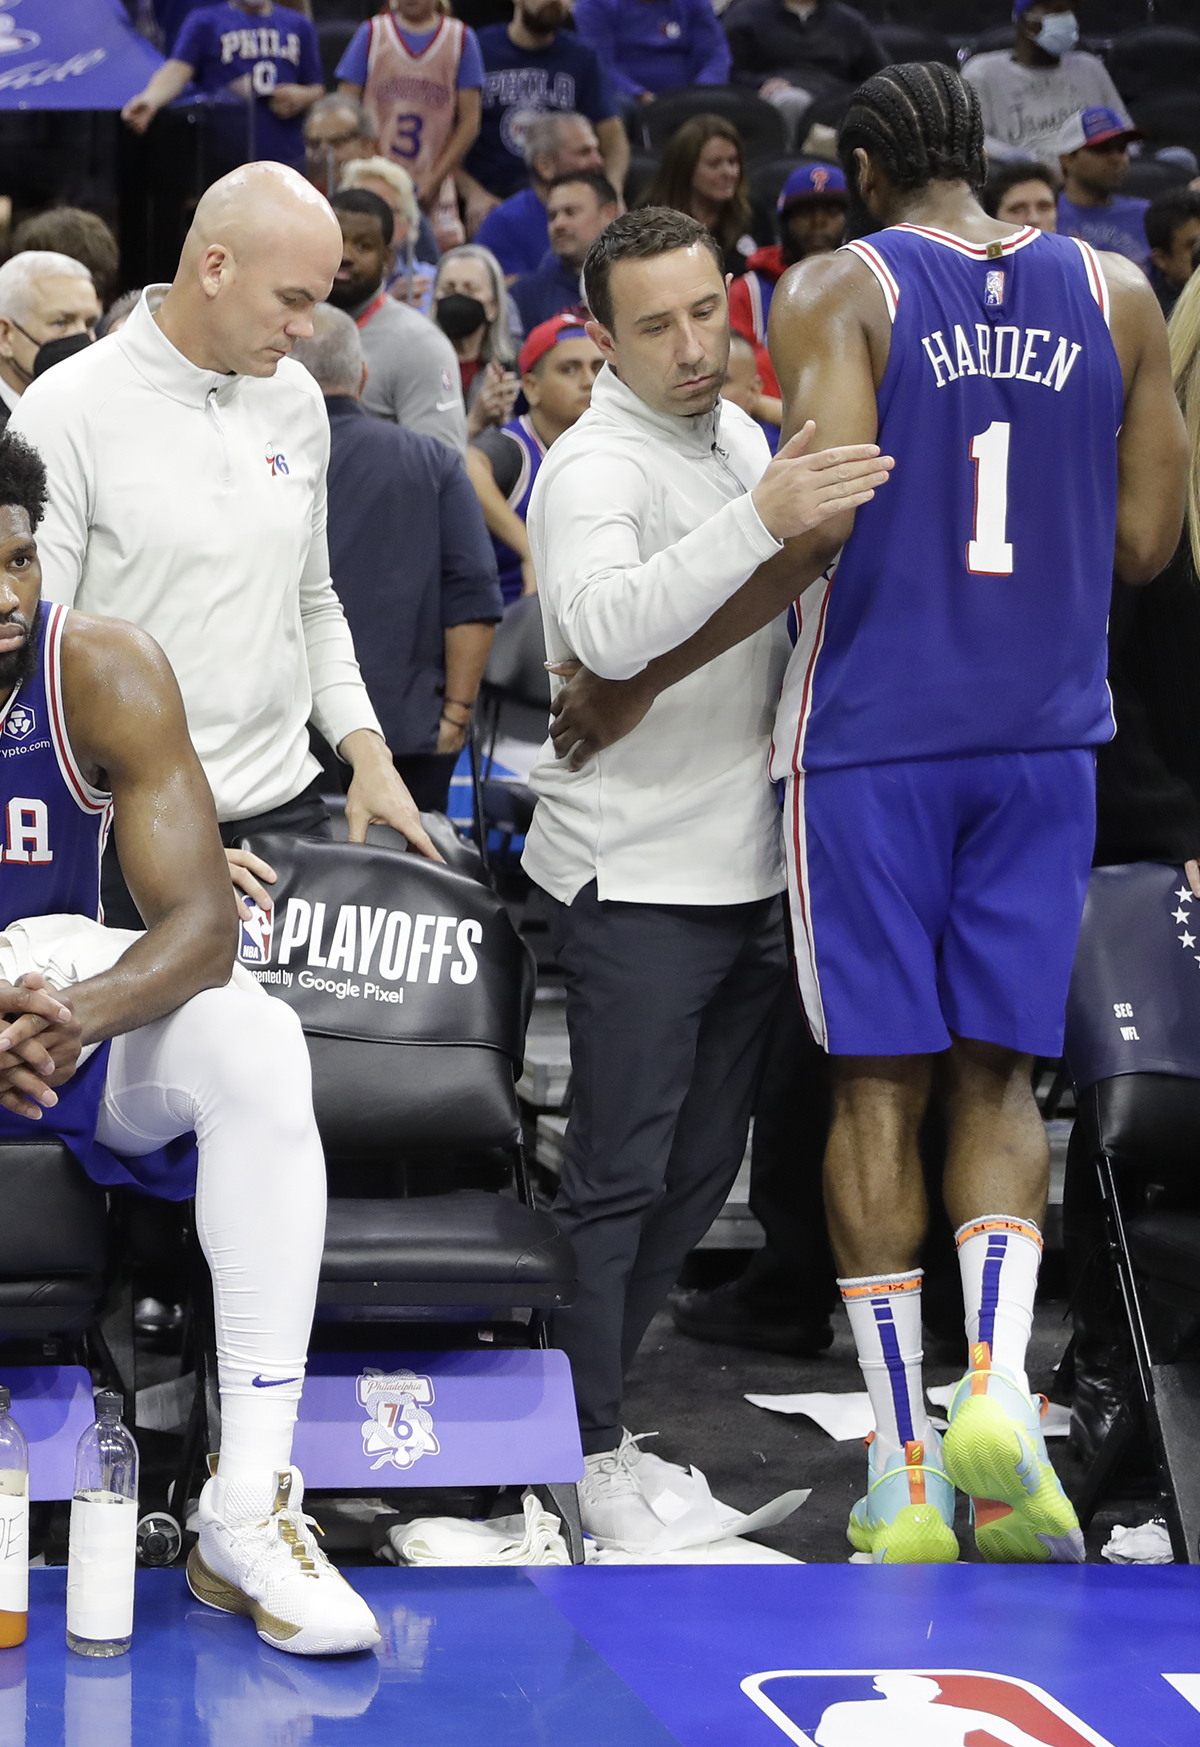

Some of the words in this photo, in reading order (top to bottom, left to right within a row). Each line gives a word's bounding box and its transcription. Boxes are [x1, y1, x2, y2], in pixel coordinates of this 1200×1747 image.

[390, 113, 424, 160] 3
[921, 322, 1083, 392] HARDEN
[265, 453, 290, 477] 76
[965, 421, 1014, 577] 1
[242, 945, 259, 959] NBA
[278, 898, 483, 985] PLAYOFFS
[282, 970, 294, 988] by
[298, 971, 360, 999] Google
[363, 982, 404, 1004] Pixel
[1113, 1002, 1134, 1018] SEC
[1120, 1026, 1140, 1041] WFL
[367, 1380, 423, 1394] Philadelphia
[384, 1403, 414, 1440] 76
